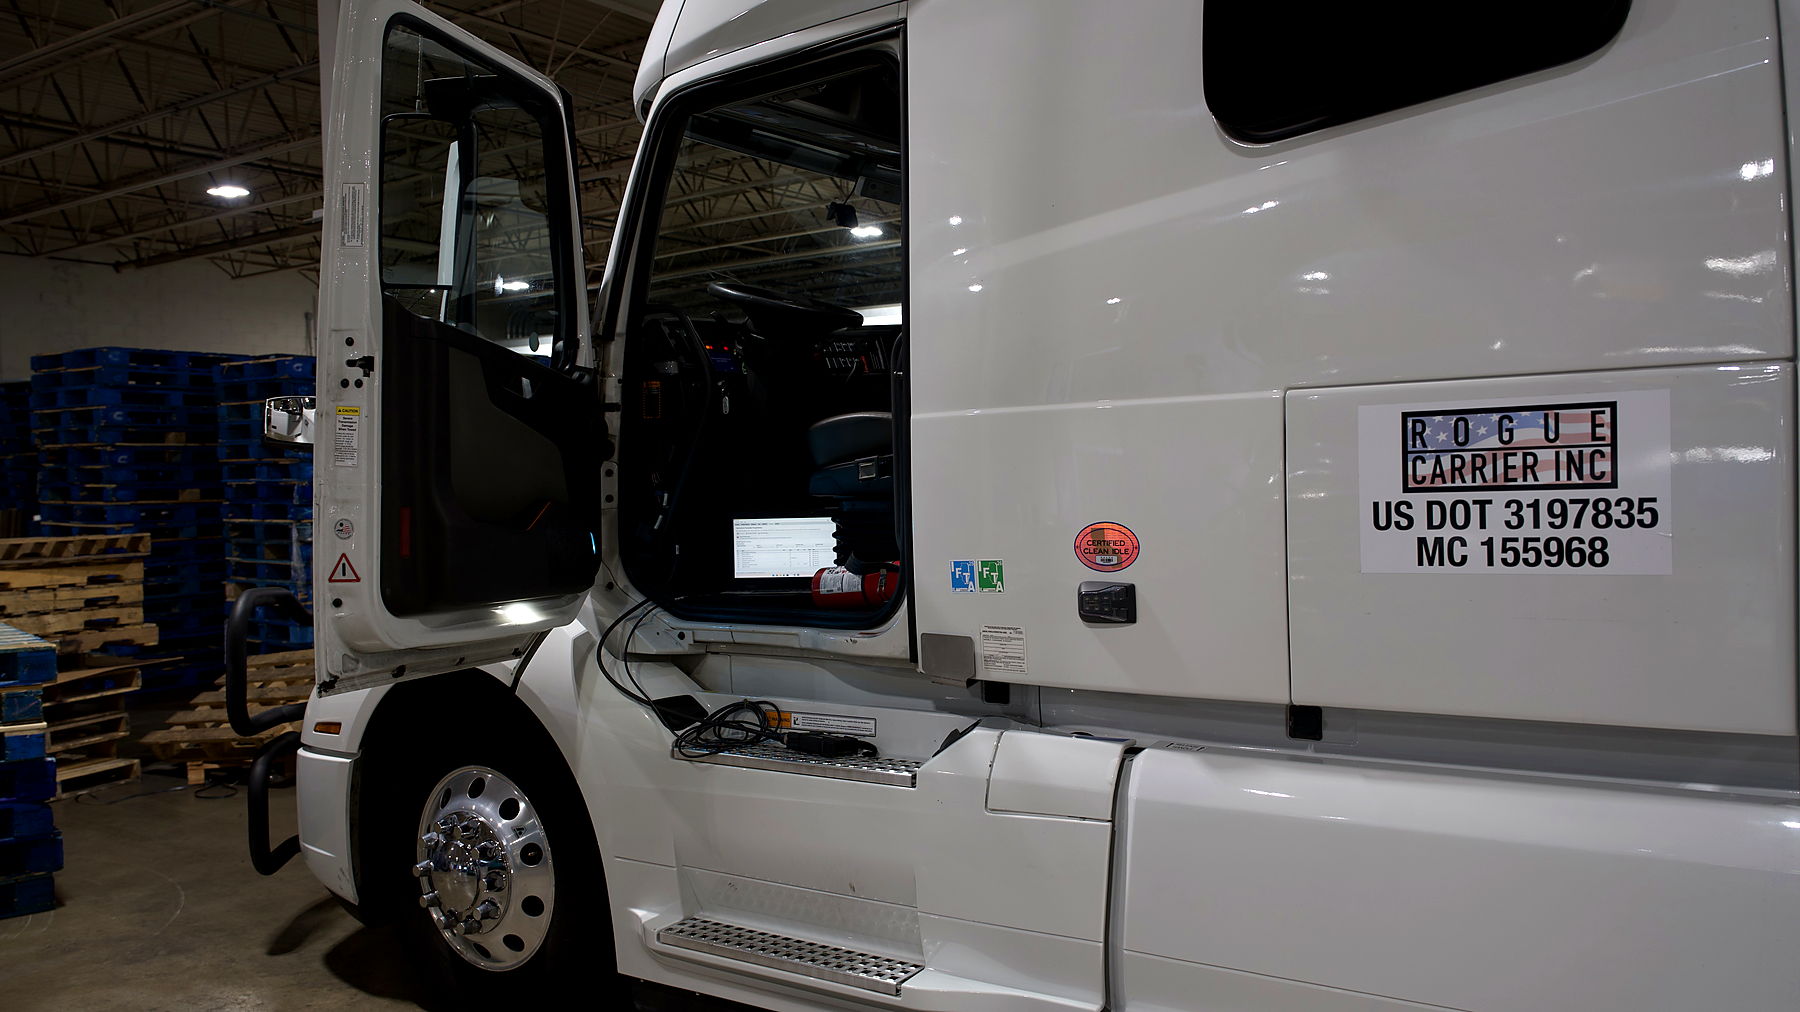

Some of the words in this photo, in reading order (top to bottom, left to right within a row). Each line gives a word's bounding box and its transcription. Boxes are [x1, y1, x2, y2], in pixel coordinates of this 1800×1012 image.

[1411, 409, 1607, 449] ROGUE
[1411, 451, 1540, 486] CARRIER
[1554, 448, 1607, 482] INC
[1372, 500, 1415, 532] US
[1426, 499, 1493, 531] DOT
[1503, 497, 1659, 530] 3197835
[1083, 547, 1109, 555] CLEAN
[1086, 539, 1126, 547] CERTIFIED
[1416, 536, 1469, 568] MC
[1480, 535, 1610, 569] 155968
